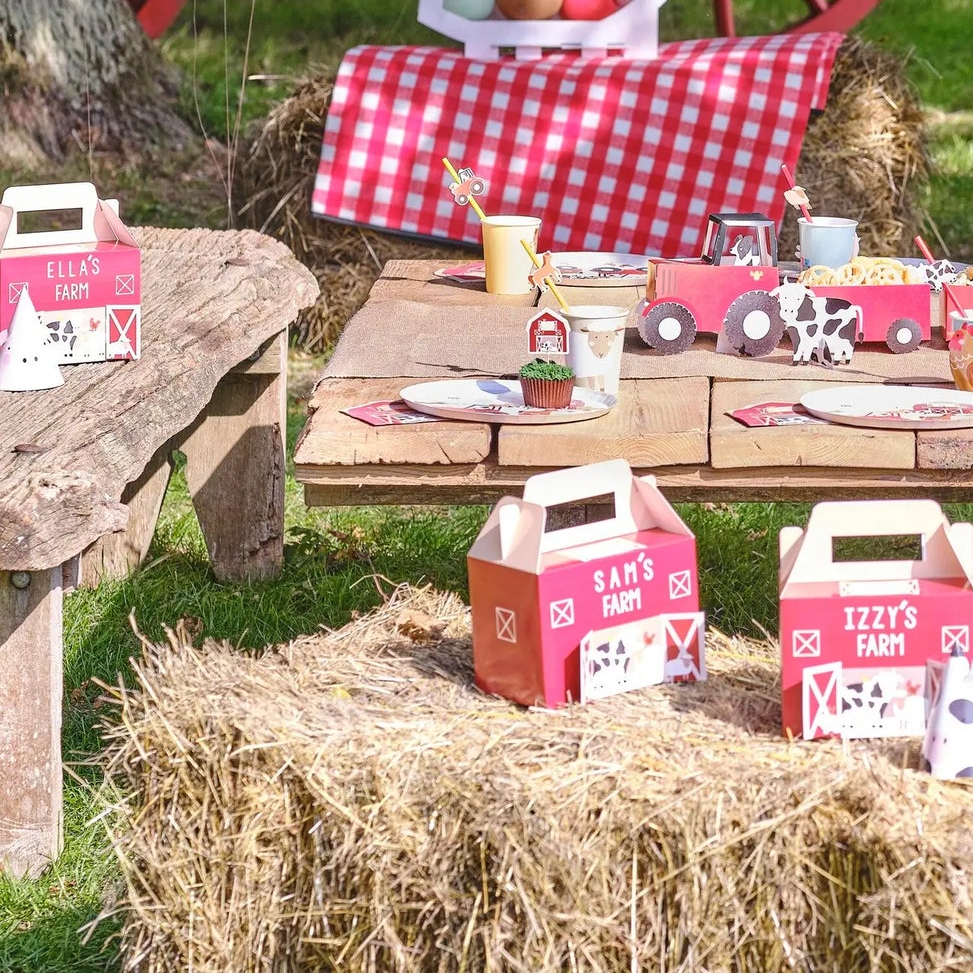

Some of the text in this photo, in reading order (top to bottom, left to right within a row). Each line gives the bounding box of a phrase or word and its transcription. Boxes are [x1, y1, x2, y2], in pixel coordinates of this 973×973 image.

[47, 254, 100, 278] ELLA'S
[55, 283, 89, 301] FARM
[593, 552, 654, 593] SAM'S
[602, 587, 641, 618] FARM
[843, 599, 917, 630] IZZY'S
[857, 632, 904, 657] FARM
